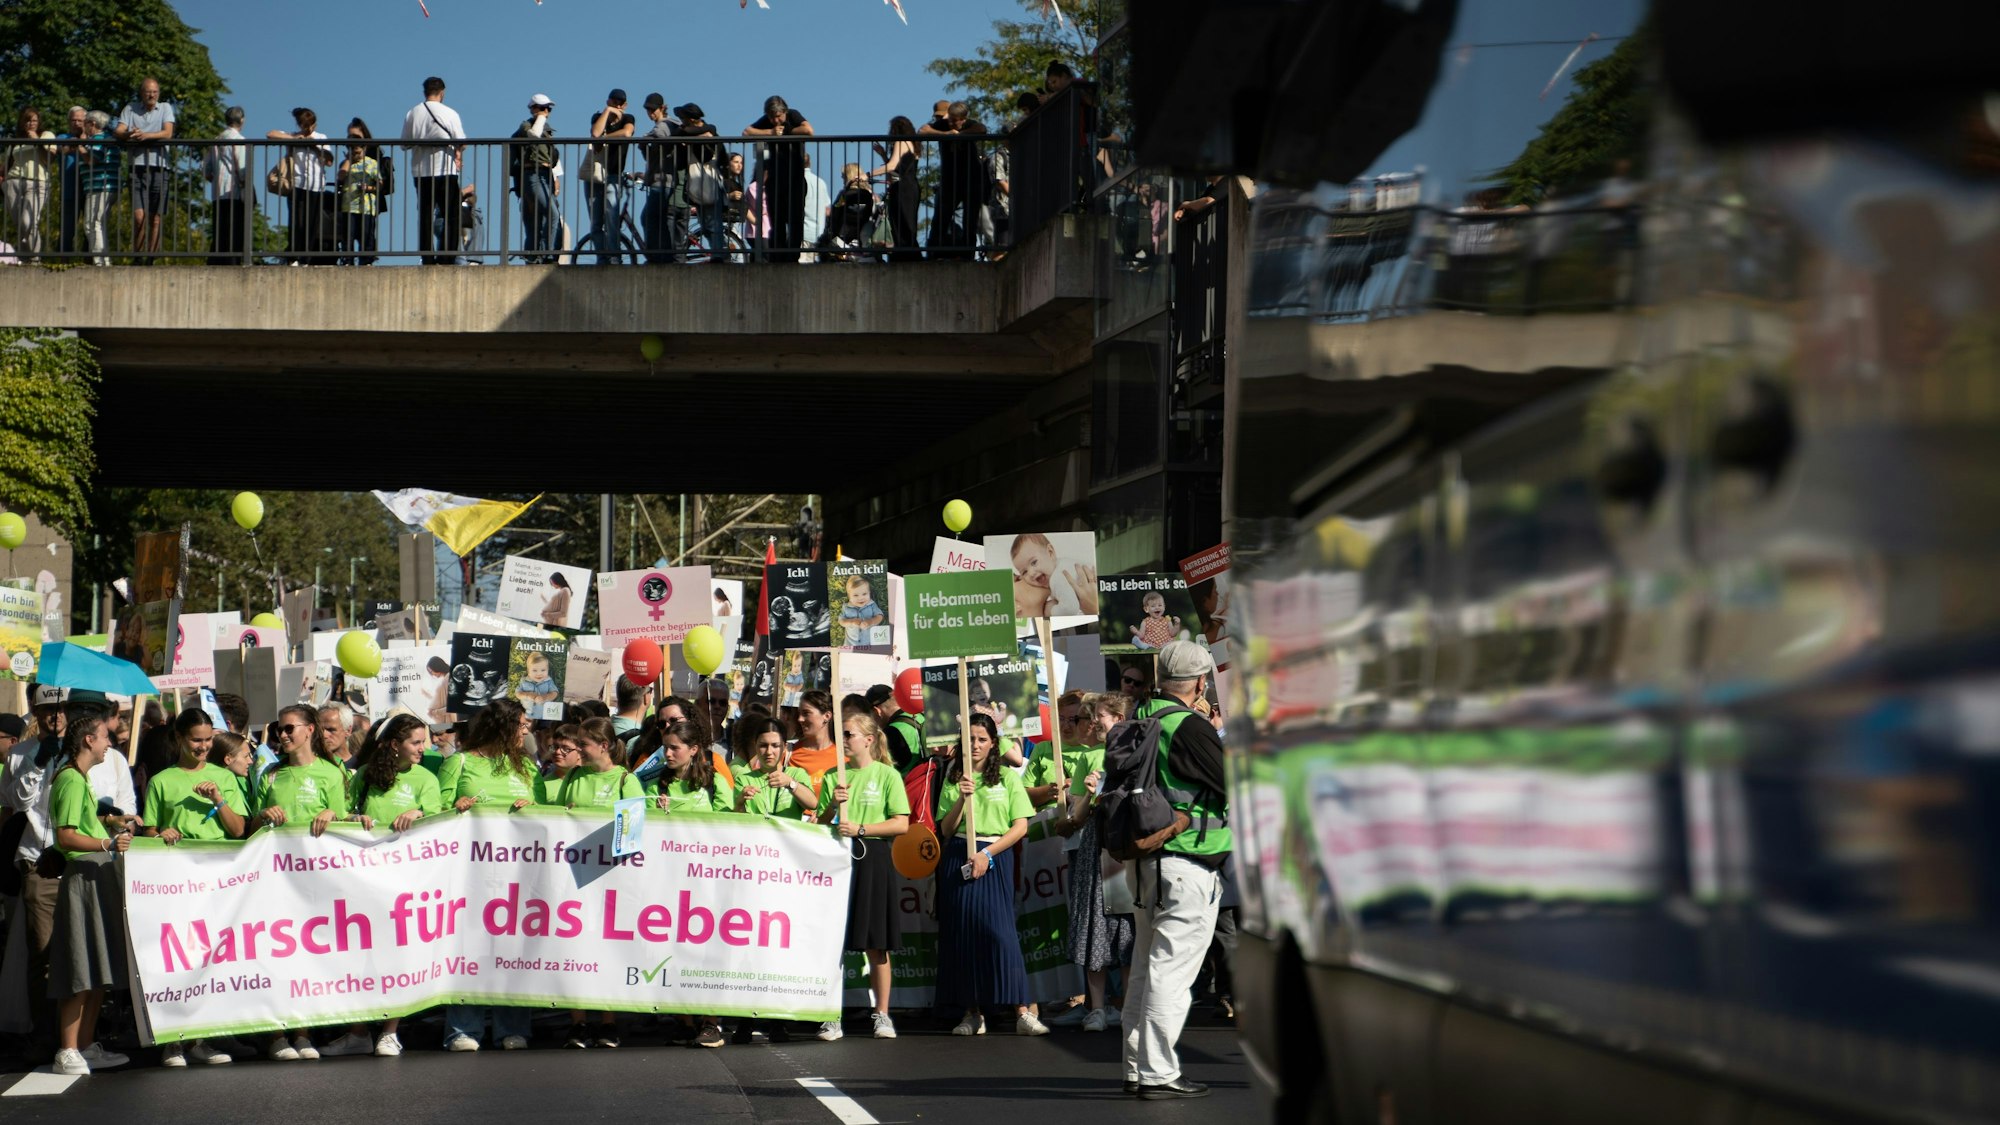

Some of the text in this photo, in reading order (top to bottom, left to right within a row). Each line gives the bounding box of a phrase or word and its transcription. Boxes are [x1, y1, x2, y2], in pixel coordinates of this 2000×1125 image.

[787, 568, 809, 578] Ich!
[832, 564, 884, 576] Auch ich!
[509, 576, 527, 584] Liebe
[1100, 580, 1118, 592] Das
[1121, 579, 1152, 590] Leben
[1155, 578, 1170, 589] ist
[516, 586, 534, 594] auch!
[3, 594, 34, 607] Ich bin
[920, 590, 1002, 608] Hebammen
[913, 609, 1010, 630] für das Leben
[605, 625, 665, 636] Frauenrechte
[472, 638, 493, 649] Ich!
[516, 641, 564, 653] Auch ich!
[573, 654, 591, 663] Danke,
[185, 666, 212, 676] beginnen
[377, 673, 421, 683] Liebe mich
[925, 660, 1032, 682] Das Len ist schön!
[168, 676, 201, 685] Mutterleib!
[43, 690, 63, 698] VANS
[389, 685, 410, 694] auch!
[273, 839, 459, 872] Marsch fürs Läbe
[470, 840, 546, 862] March
[554, 841, 591, 864] for
[661, 840, 780, 858] Marcia per la Vita
[132, 870, 260, 894] Mars voor he Leven
[687, 863, 833, 887] Marcha pela Vida
[160, 882, 791, 973] Marsch für das Leben
[495, 956, 598, 973] Pochod za život
[626, 957, 672, 987] BVL
[290, 956, 478, 999] Marche pour la Vie
[680, 969, 828, 985] BUNDESVERBAND LEBENSRECHT E.V.
[184, 983, 206, 1003] por
[211, 978, 226, 994] la
[230, 973, 271, 991] Vida
[680, 981, 827, 997] www.bundesverband-lebensrecht.de
